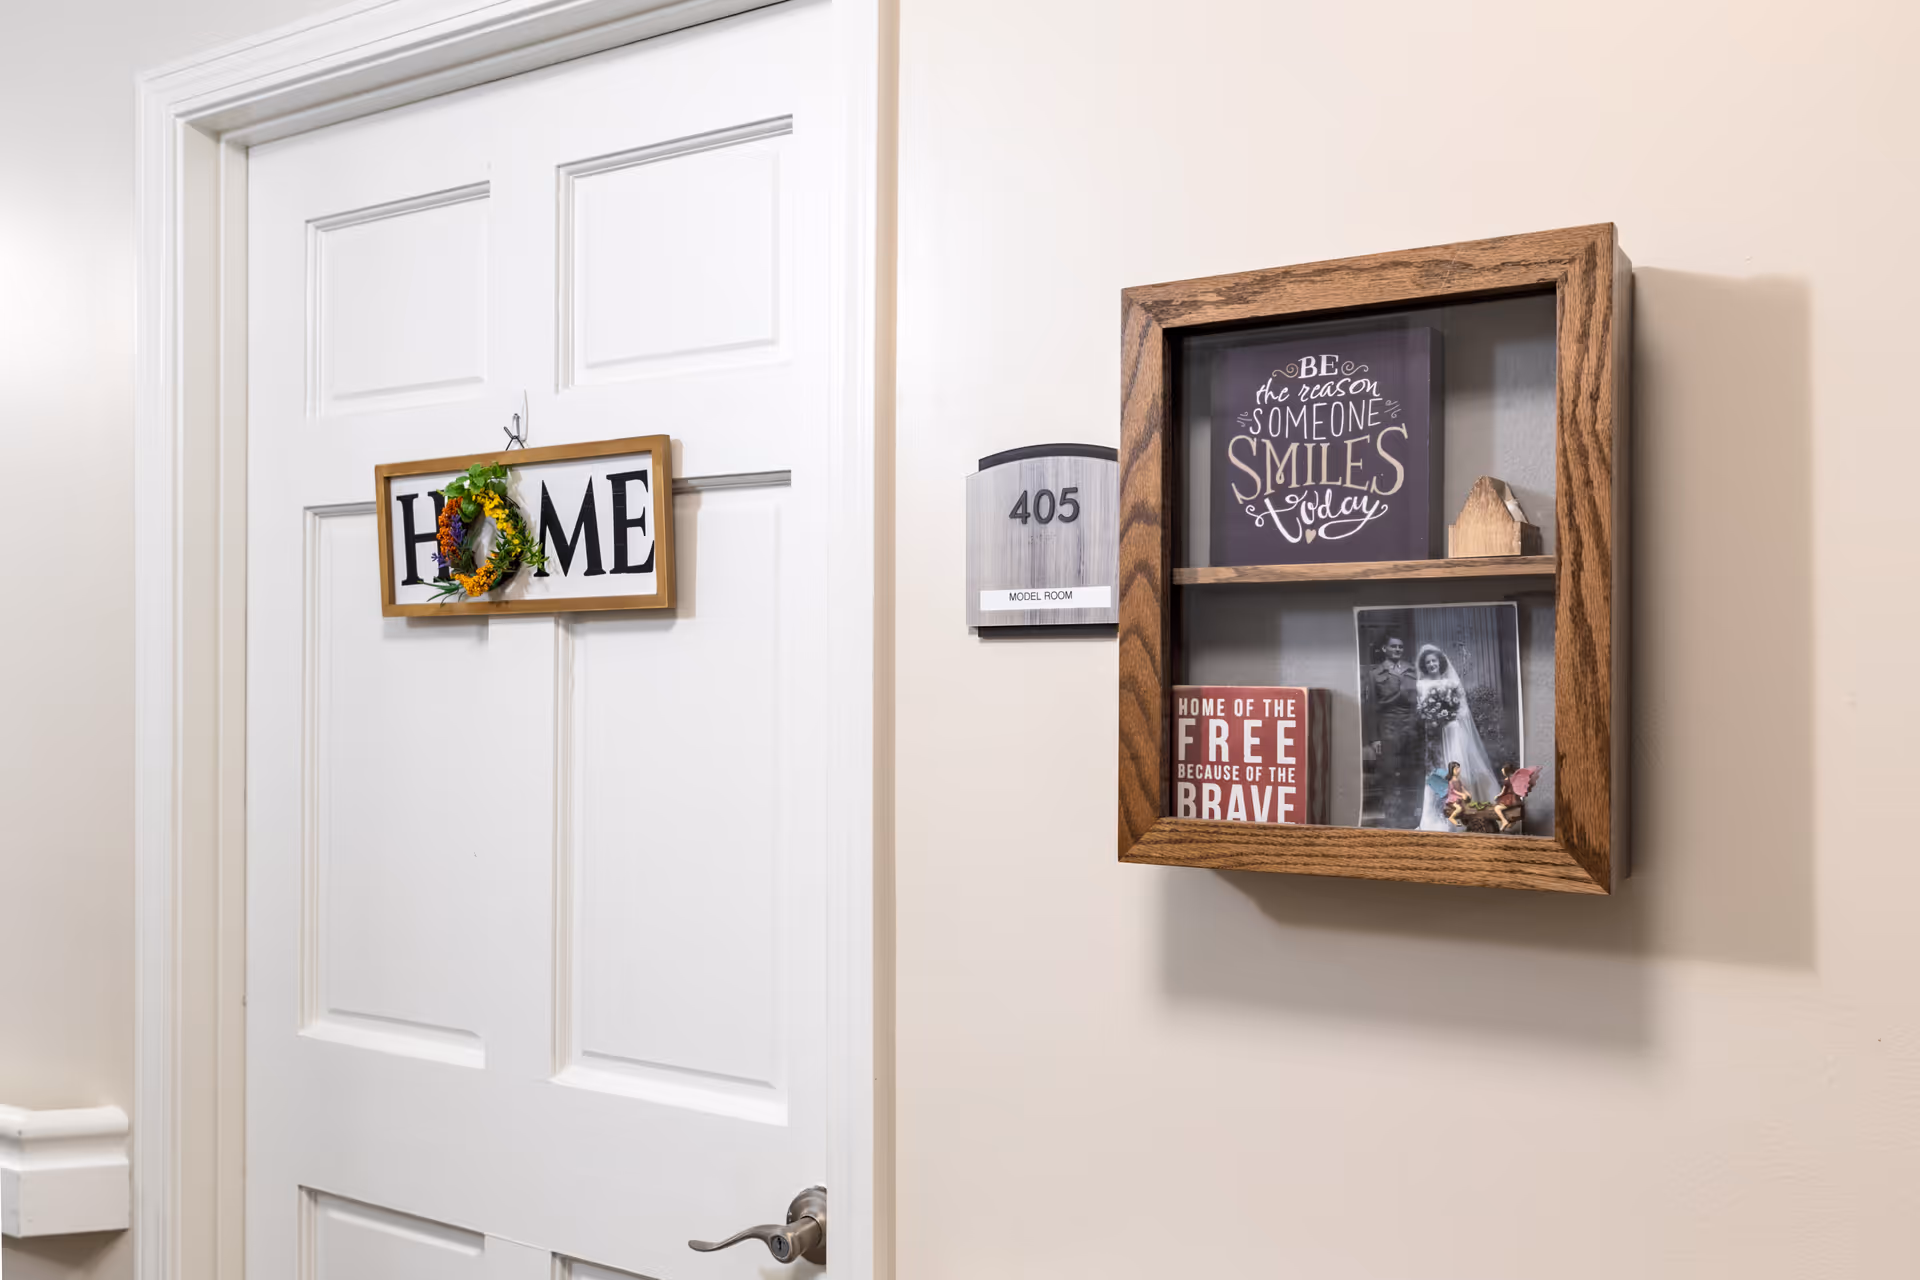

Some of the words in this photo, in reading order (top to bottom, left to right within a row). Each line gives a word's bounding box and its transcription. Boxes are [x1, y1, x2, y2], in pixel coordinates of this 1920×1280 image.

[1298, 354, 1339, 379] BE
[1256, 377, 1290, 405] the
[1298, 378, 1381, 402] reason
[1249, 398, 1383, 440] SOMEONE
[1228, 423, 1408, 505] SMILES
[1008, 487, 1080, 525] 405
[1245, 488, 1388, 543] today
[1009, 592, 1041, 601] MODEL
[1044, 591, 1073, 600] ROOM
[1178, 698, 1225, 716] HOME
[1234, 698, 1254, 717] OF
[1263, 699, 1296, 718] THE
[1178, 718, 1296, 764] FREE
[1178, 764, 1240, 781] BECAUSE
[1246, 766, 1263, 781] OF
[1269, 767, 1296, 783] THE
[1177, 782, 1296, 824] BRAVE
